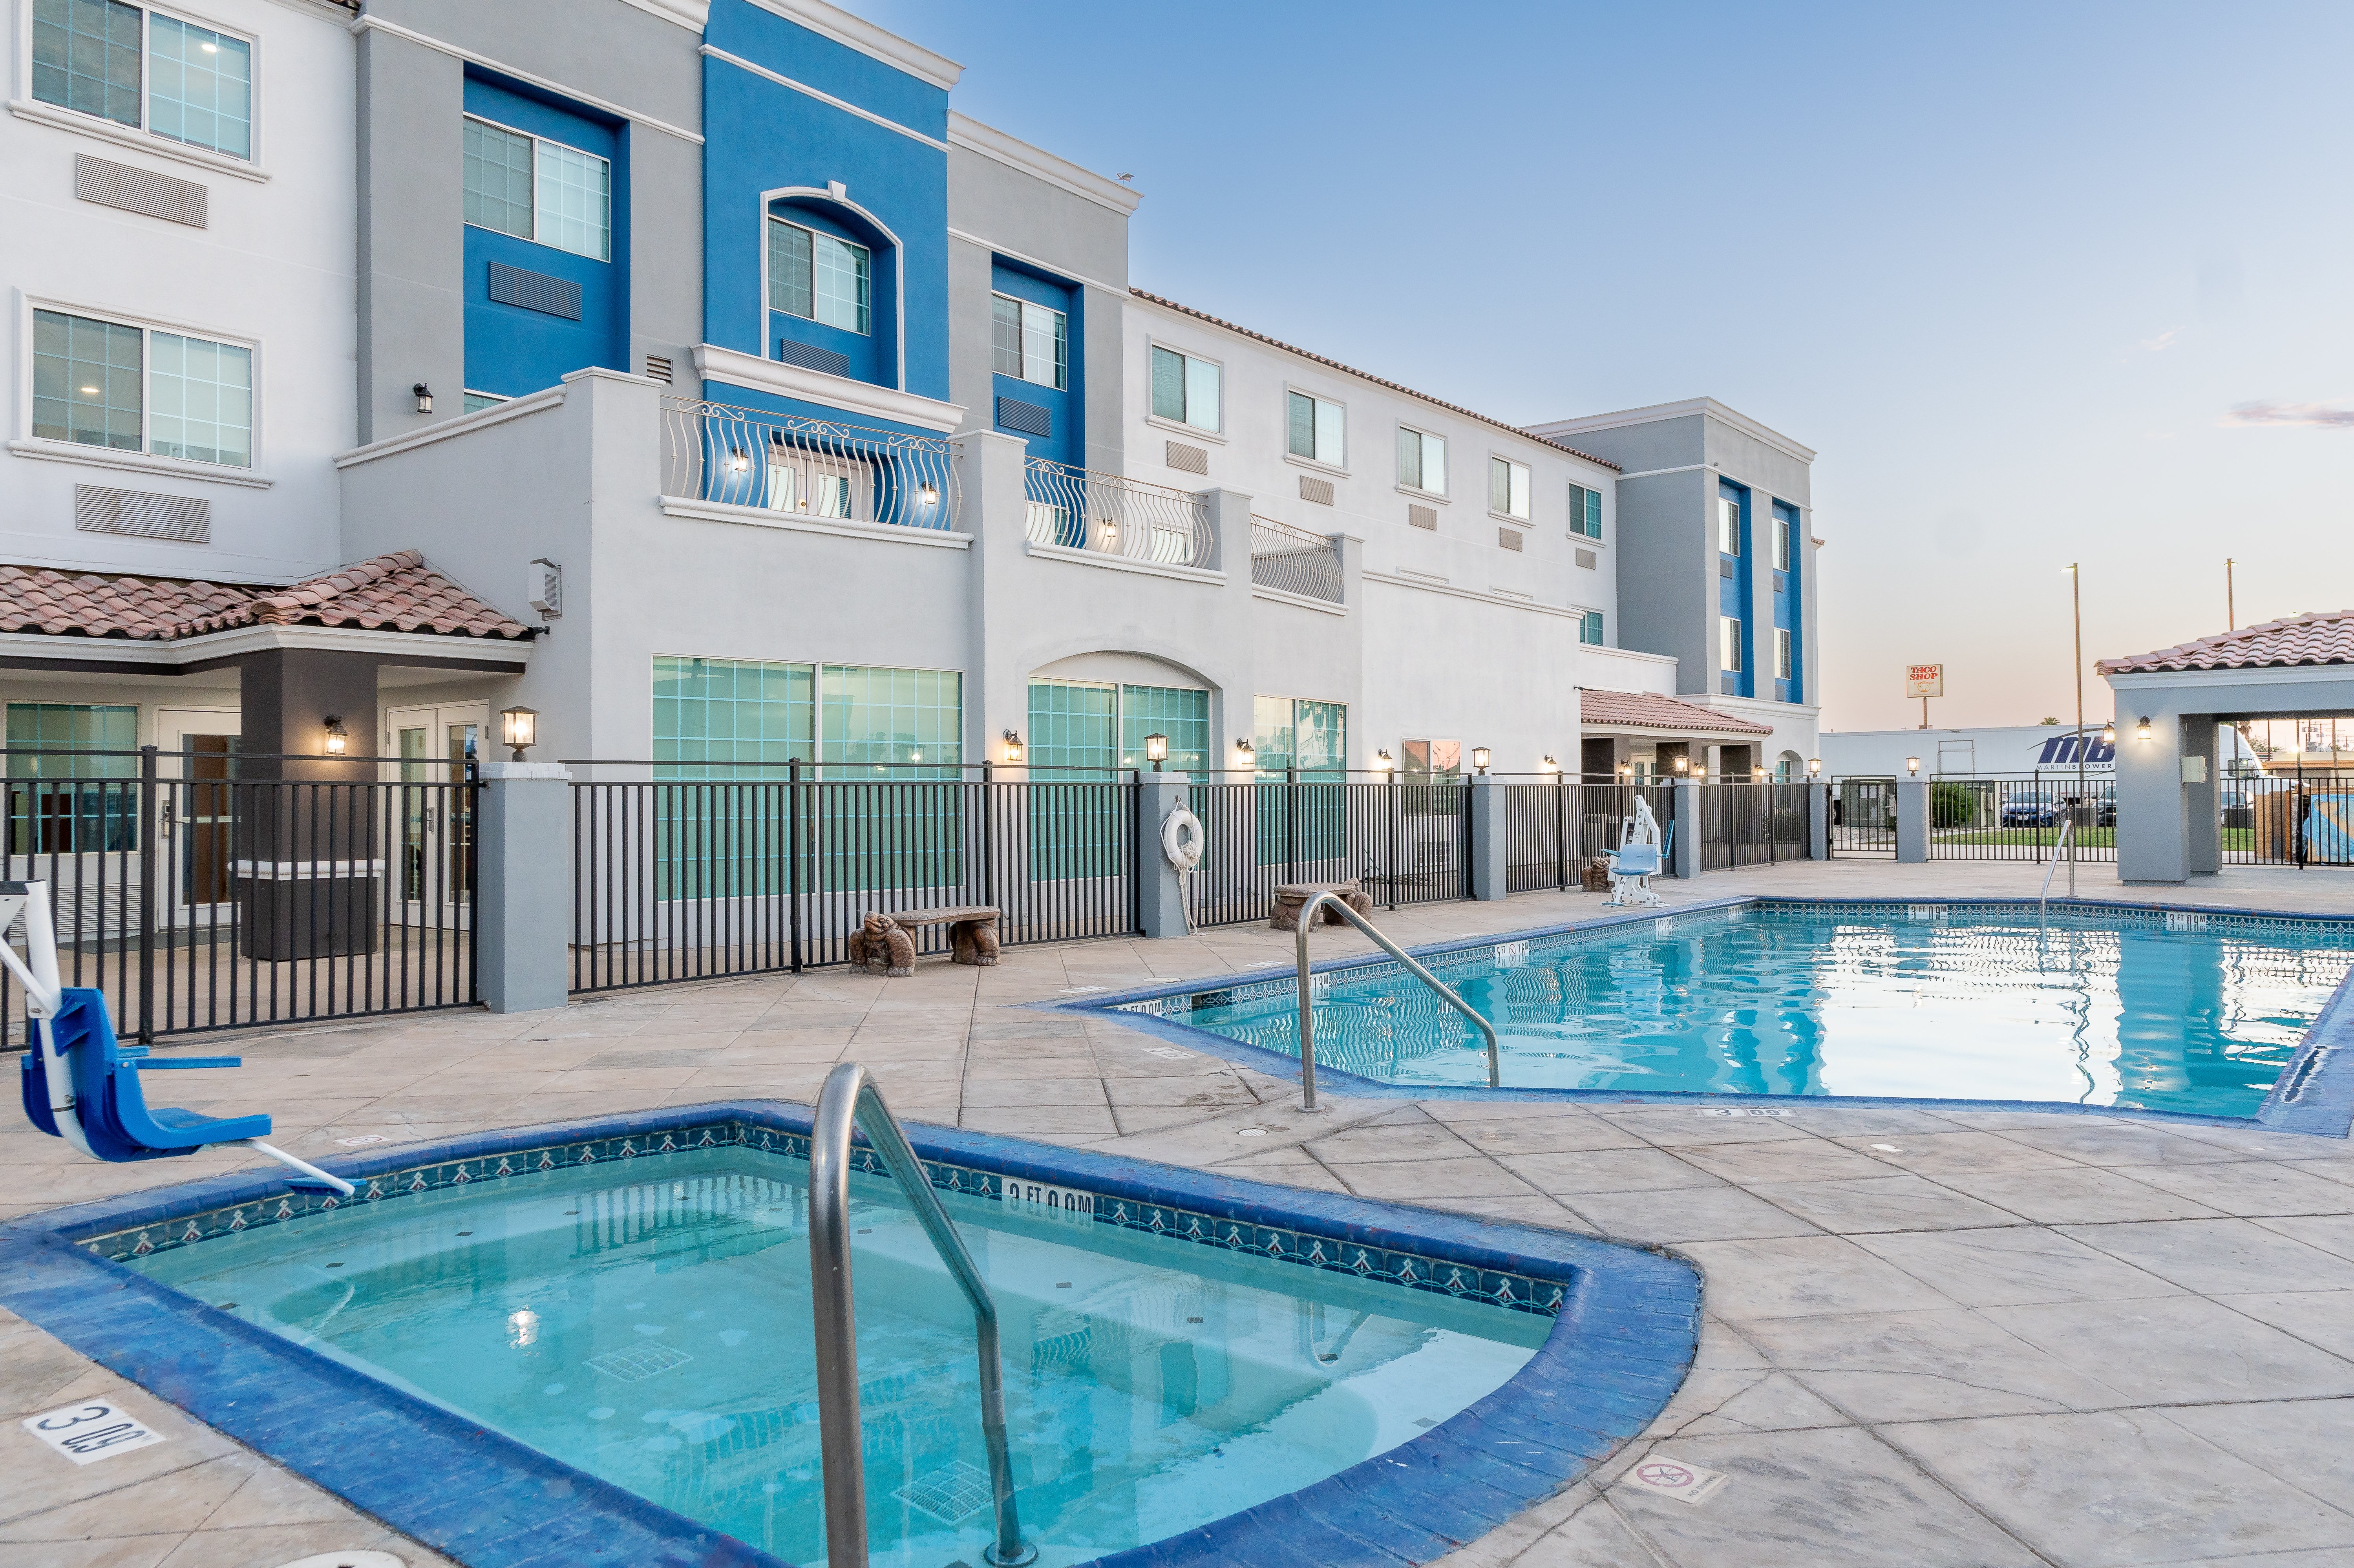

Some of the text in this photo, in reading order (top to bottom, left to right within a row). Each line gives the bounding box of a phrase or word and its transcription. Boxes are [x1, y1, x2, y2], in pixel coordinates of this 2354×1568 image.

[1501, 946, 1505, 954] FT
[1027, 1185, 1042, 1203] FT
[37, 1405, 111, 1431] 3
